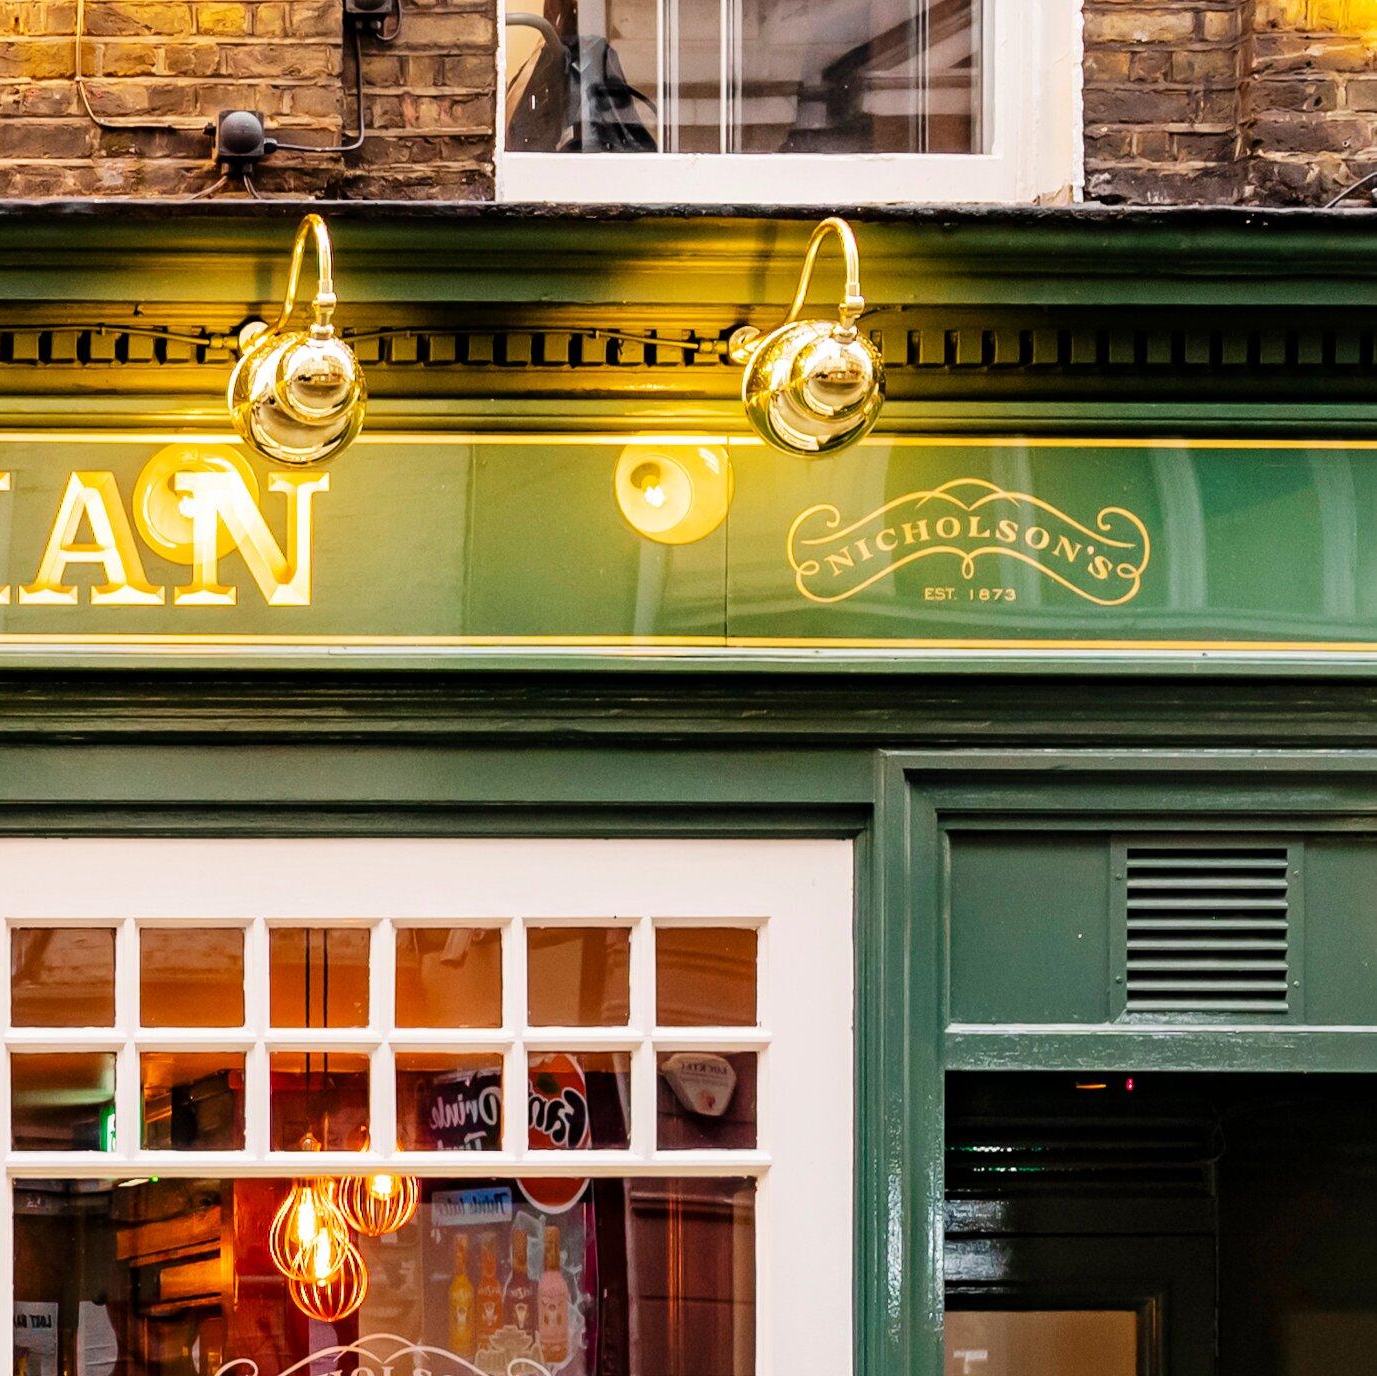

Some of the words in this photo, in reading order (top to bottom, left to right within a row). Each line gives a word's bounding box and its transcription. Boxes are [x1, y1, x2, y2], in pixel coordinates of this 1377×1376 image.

[823, 515, 1113, 580] NICHOLSON'S
[924, 588, 956, 600] EST.
[969, 588, 1017, 600] 1873
